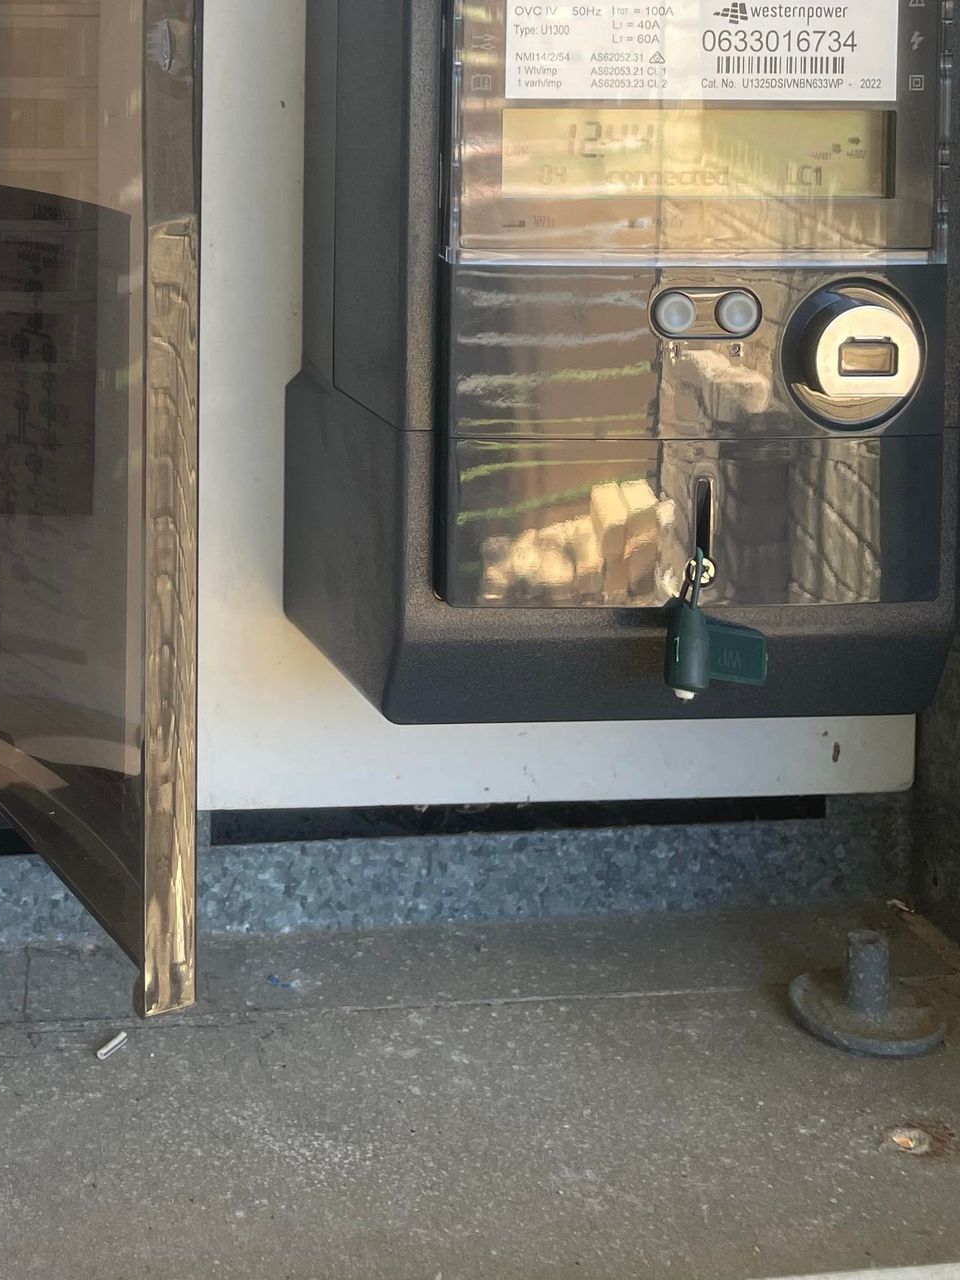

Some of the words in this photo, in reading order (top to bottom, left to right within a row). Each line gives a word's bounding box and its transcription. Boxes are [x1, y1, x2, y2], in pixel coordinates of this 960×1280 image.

[514, 6, 542, 16] OVC
[545, 6, 558, 16] IV
[571, 6, 602, 16] 50Hz
[644, 6, 674, 16] 100A
[750, 4, 849, 26] westernpower
[637, 19, 661, 29] 40A
[514, 25, 538, 37] Type:
[540, 25, 570, 35] U1300
[637, 34, 660, 44] 60A
[701, 29, 858, 53] 0633016734
[590, 52, 644, 62] AS62052.31
[524, 66, 558, 76] Wh/imp
[590, 66, 644, 76] AS62053.21
[524, 79, 562, 89] varh/imp
[590, 79, 645, 89] AS62053.23
[701, 78, 719, 89] Cat.
[721, 78, 736, 89] No.
[860, 78, 882, 89] 2022
